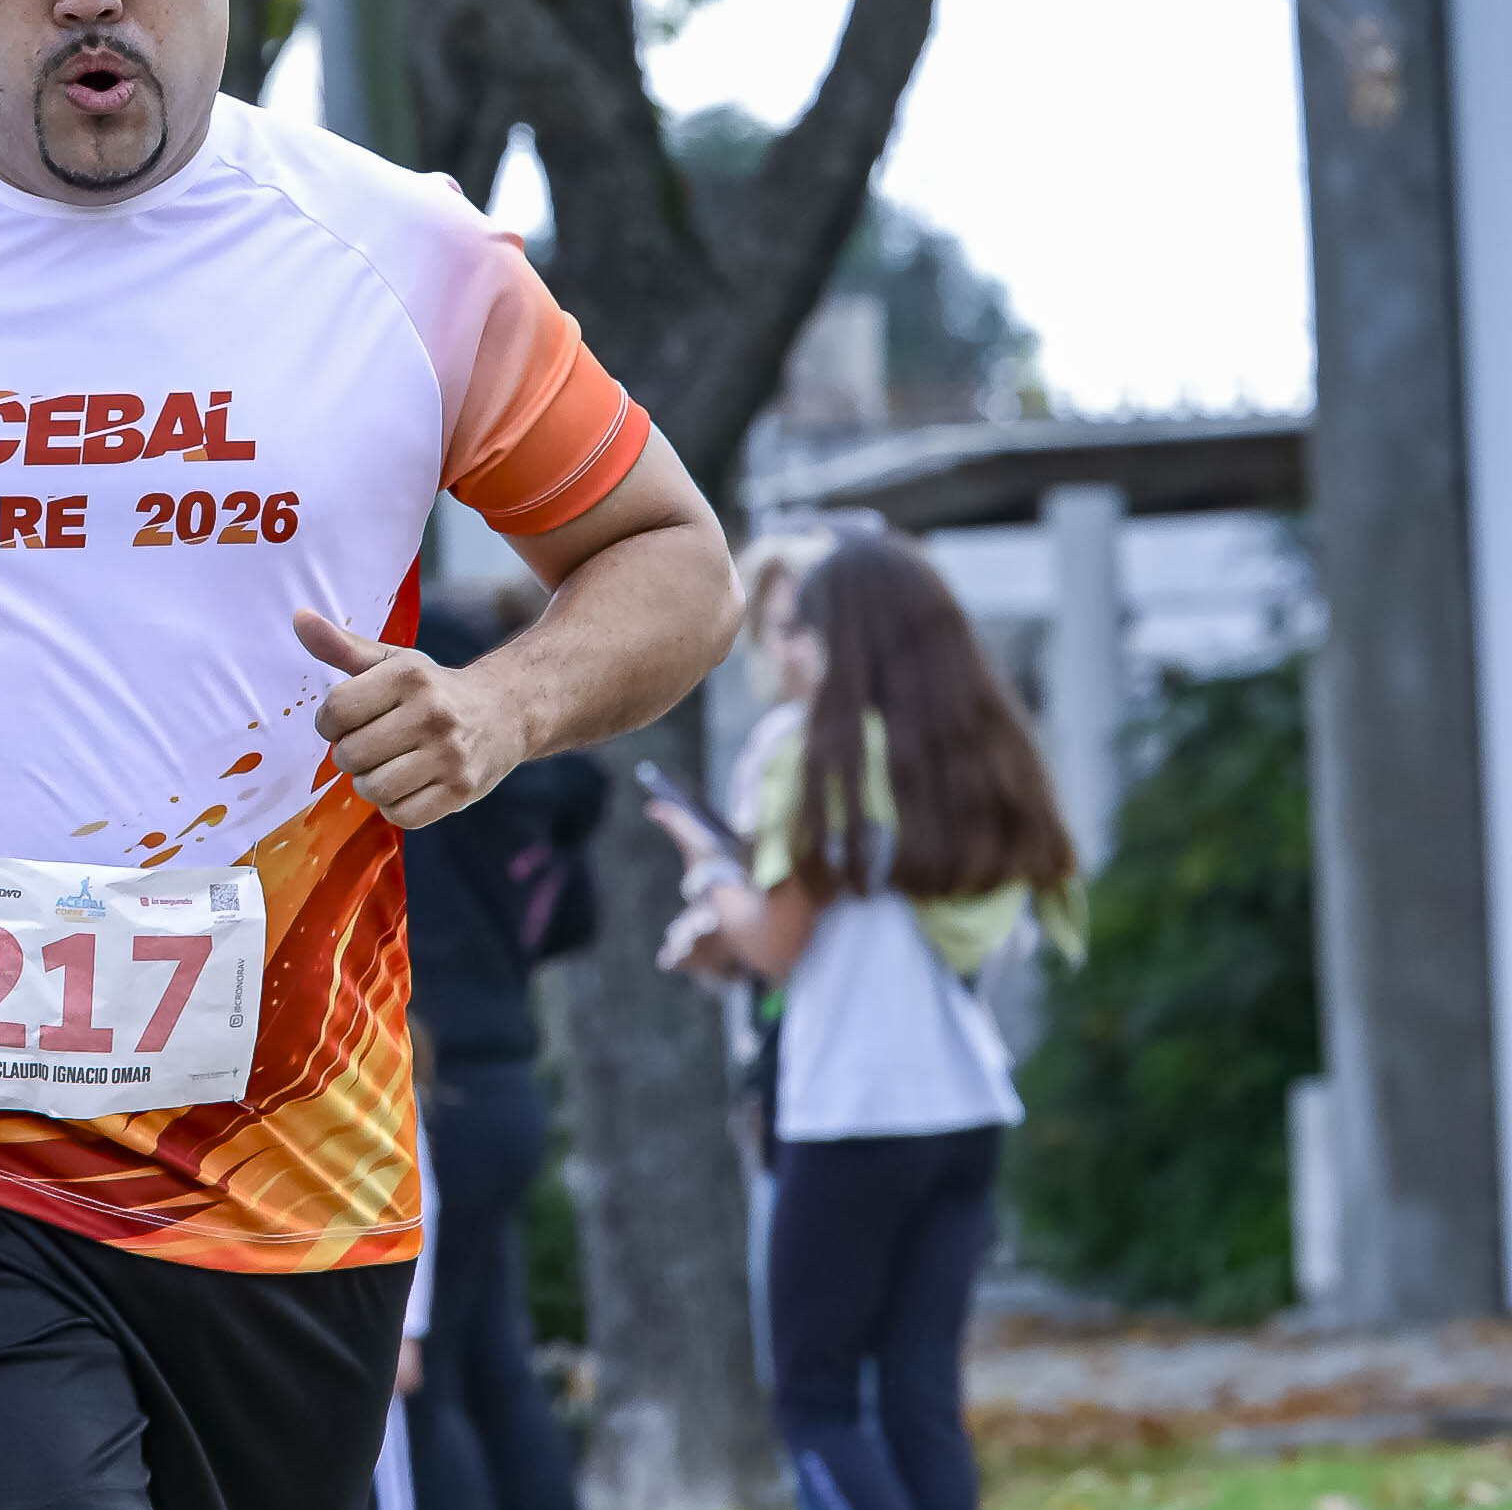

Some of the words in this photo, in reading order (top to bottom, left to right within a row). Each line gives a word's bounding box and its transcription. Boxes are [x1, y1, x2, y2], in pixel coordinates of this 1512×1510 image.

[132, 490, 300, 548] 2026
[52, 1065, 108, 1084] IGNACIO
[111, 1066, 151, 1084] OMAR
